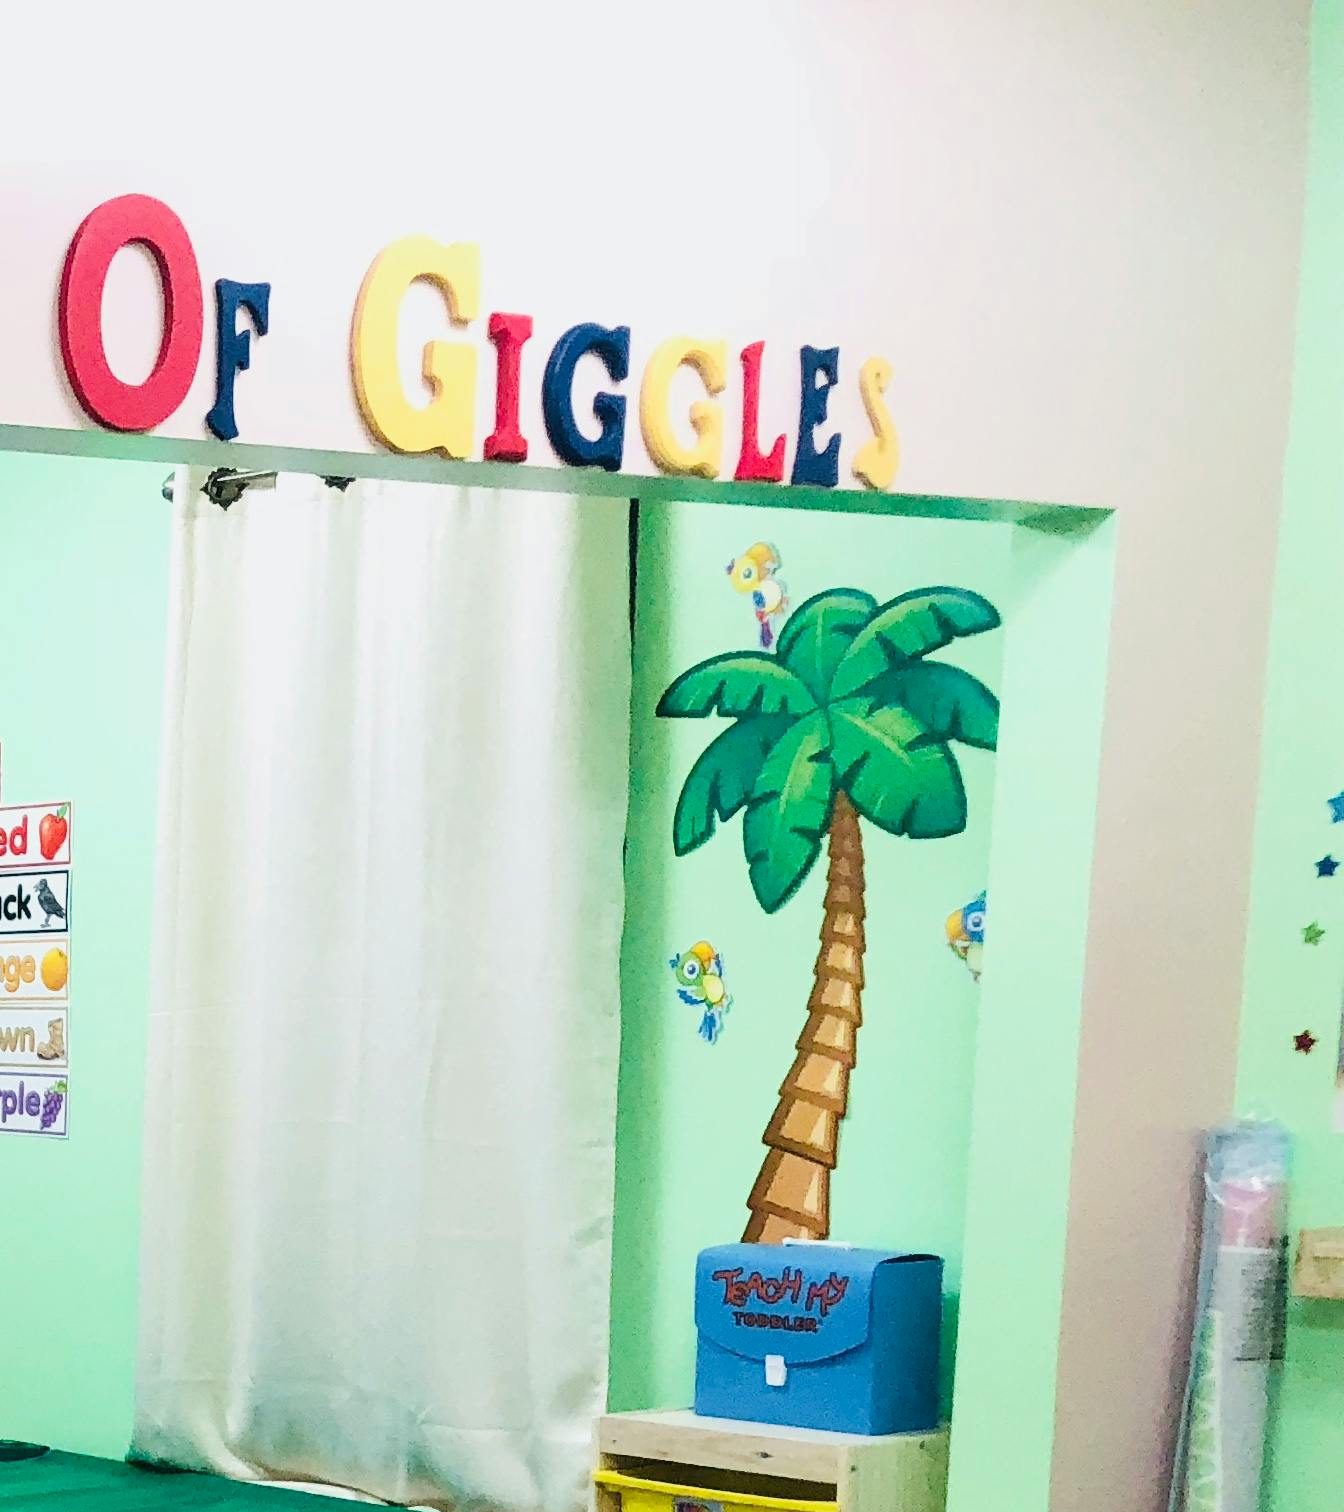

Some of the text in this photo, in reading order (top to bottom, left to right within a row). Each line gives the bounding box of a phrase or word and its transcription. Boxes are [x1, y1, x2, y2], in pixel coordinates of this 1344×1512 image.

[713, 1266, 849, 1316] TEACH MY
[732, 1311, 818, 1333] TODDLER
